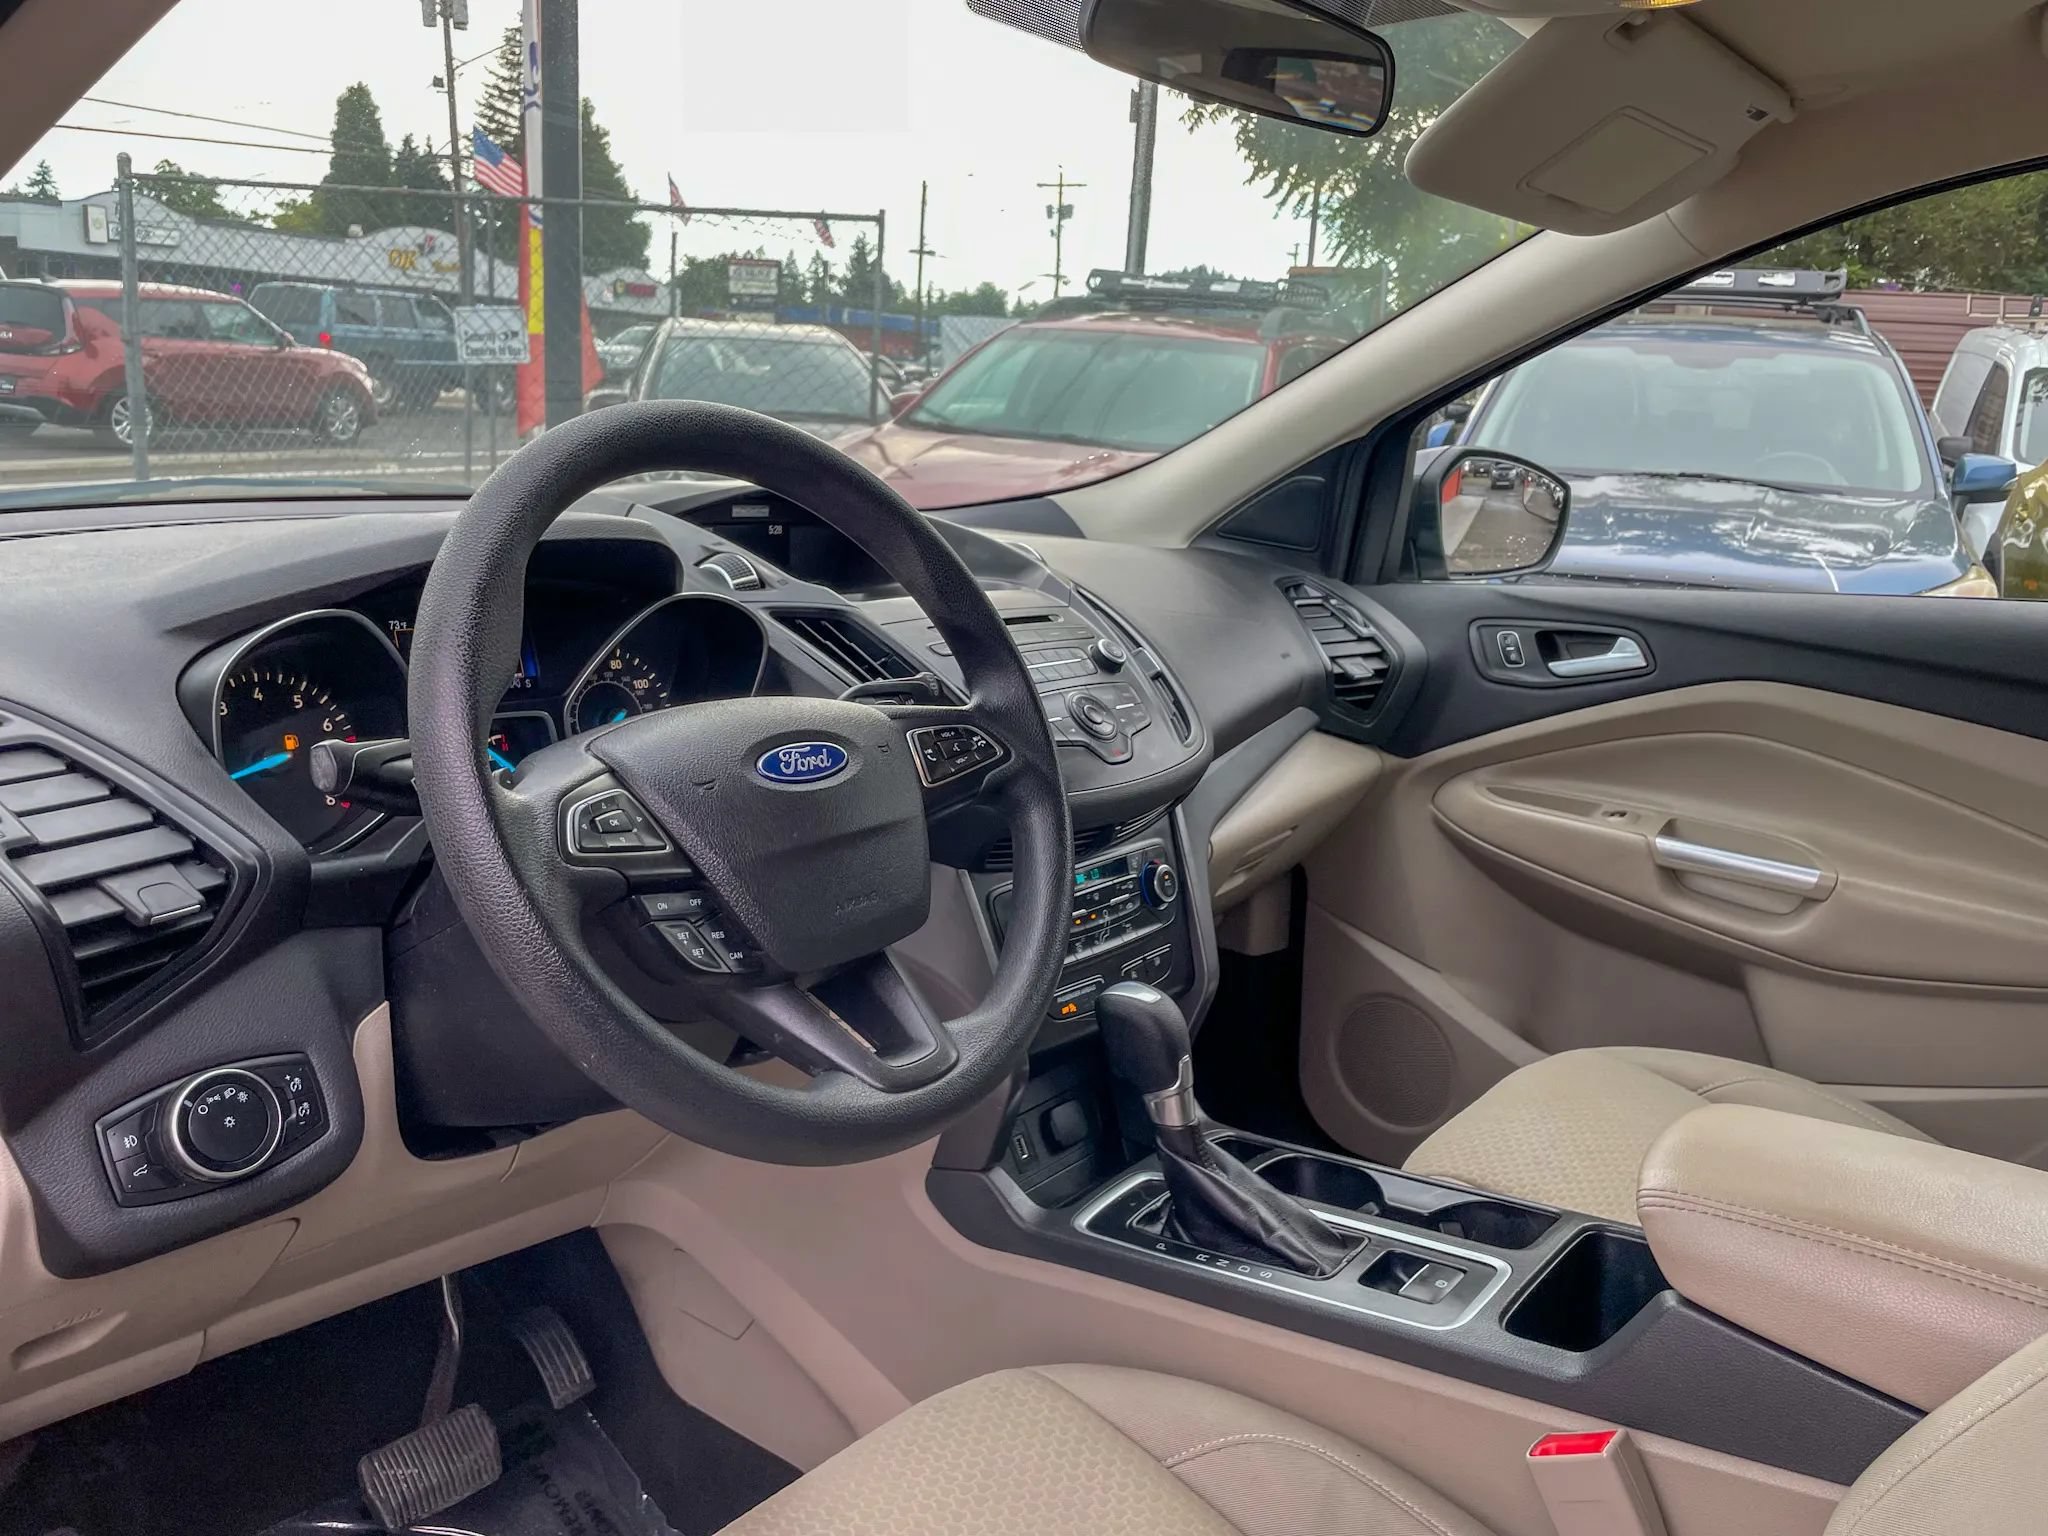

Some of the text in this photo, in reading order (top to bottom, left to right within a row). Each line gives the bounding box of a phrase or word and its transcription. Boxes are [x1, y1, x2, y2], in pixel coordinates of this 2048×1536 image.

[768, 524, 783, 535] 5:28
[610, 659, 623, 670] 80
[632, 678, 649, 689] 100
[253, 686, 264, 701] 4
[293, 694, 304, 709] 5
[219, 701, 229, 716] 3
[323, 717, 333, 732] 6
[778, 745, 832, 774] Ford
[609, 818, 620, 827] OK
[657, 898, 702, 911] ON OFF
[676, 931, 690, 941] SET
[711, 930, 725, 940] RES
[691, 947, 705, 957] SET
[728, 951, 744, 960] CAN
[1156, 1242, 1273, 1279] P R N D S
